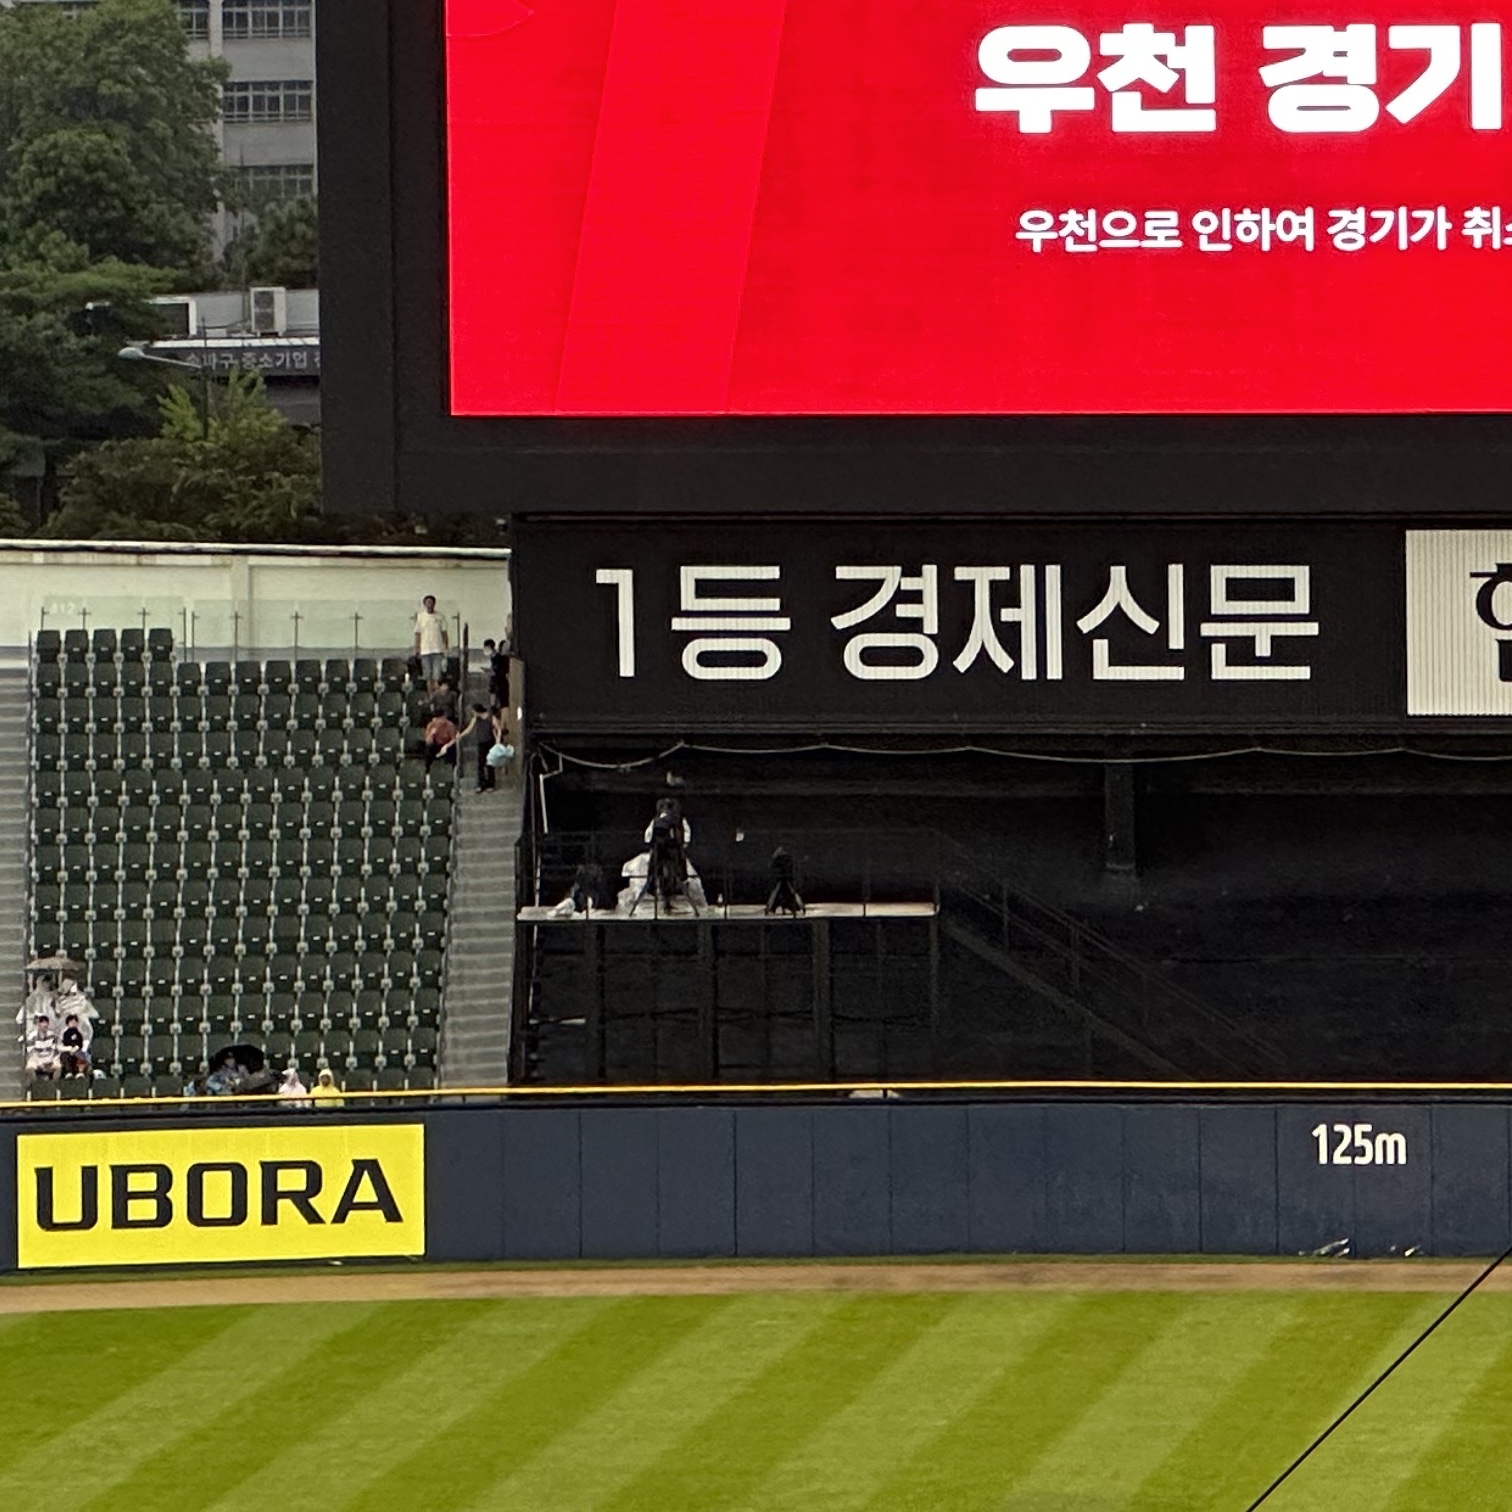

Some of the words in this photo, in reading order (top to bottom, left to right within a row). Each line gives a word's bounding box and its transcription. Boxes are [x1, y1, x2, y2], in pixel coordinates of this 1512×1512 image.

[975, 23, 1216, 133] 우천
[1259, 23, 1501, 133] 경기
[1016, 209, 1182, 252] 우천으로
[1192, 207, 1314, 251] 인하여
[1327, 206, 1452, 251] 경기가
[242, 351, 307, 369] 중소기업
[596, 564, 790, 680] 1등
[831, 564, 1318, 680] 경제신문
[1312, 1124, 1407, 1164] 125m
[35, 1159, 402, 1231] UBORA
